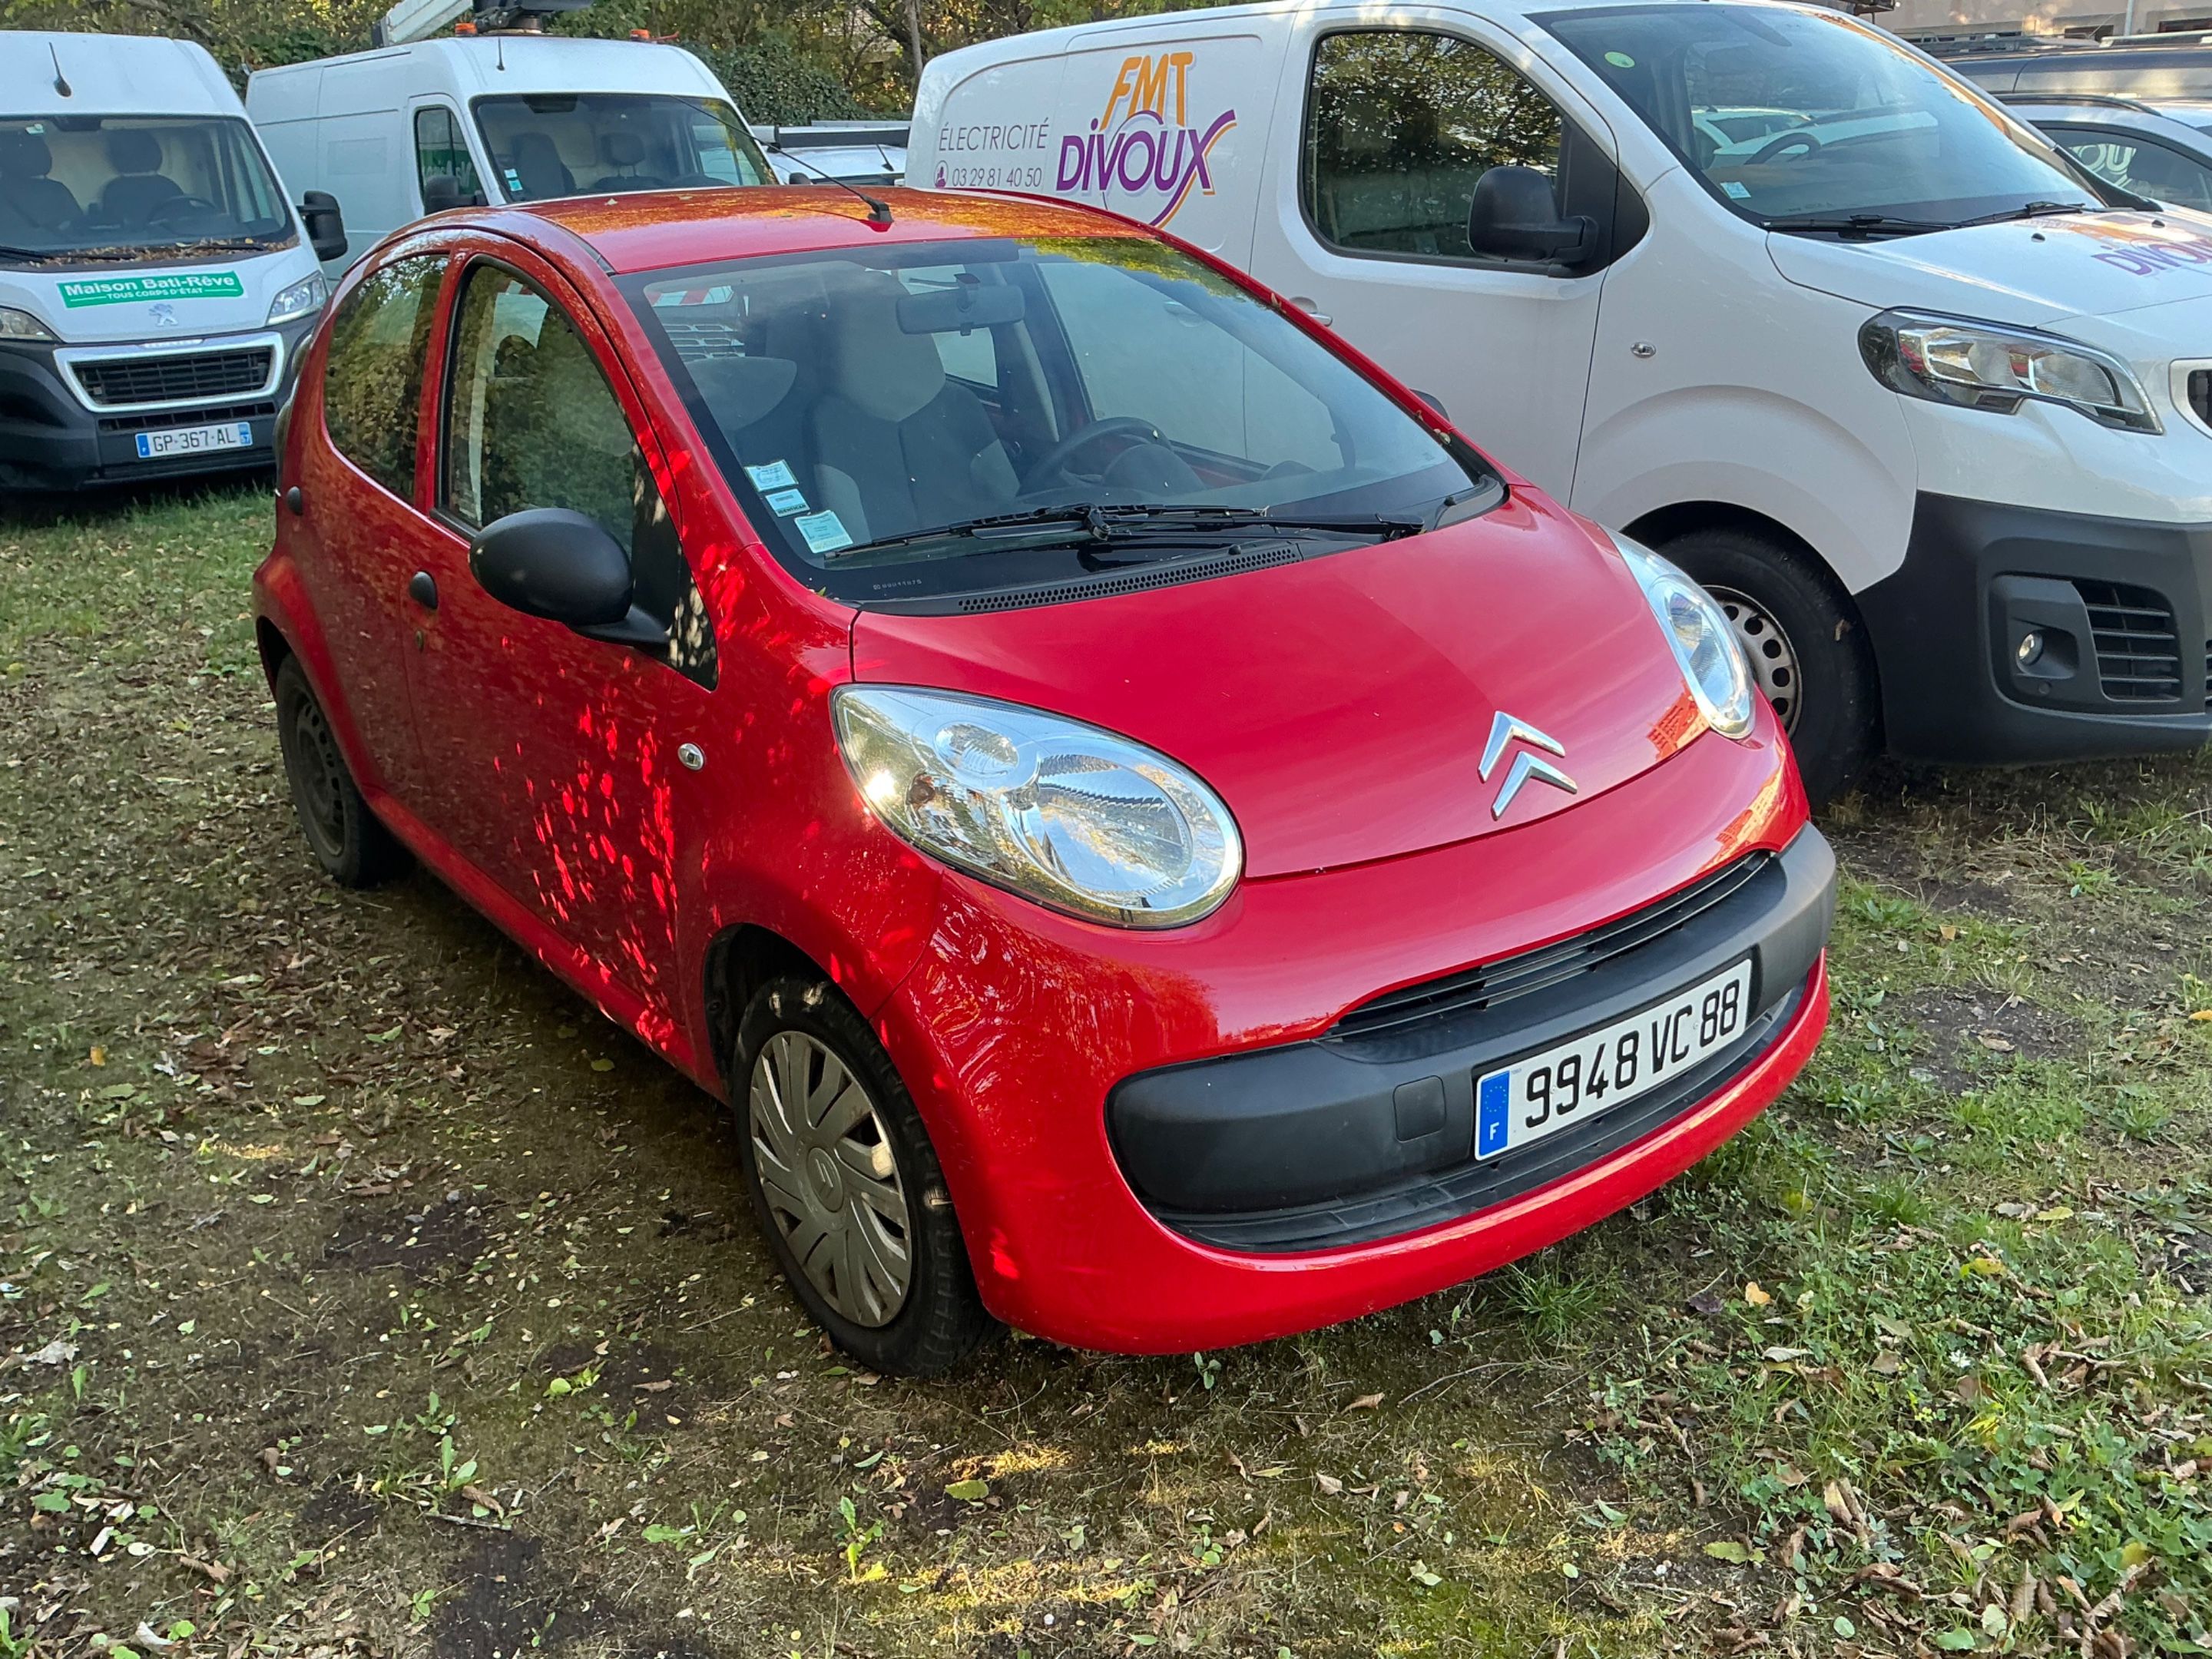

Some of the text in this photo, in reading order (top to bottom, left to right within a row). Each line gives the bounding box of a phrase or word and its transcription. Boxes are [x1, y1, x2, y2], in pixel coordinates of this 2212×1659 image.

[1099, 51, 1194, 131] FMT
[938, 117, 1049, 151] ÉLECTRICITÉ
[952, 167, 1042, 187] 03 29 81 40 50
[65, 276, 234, 296] Maison Bati-Rêve
[106, 291, 134, 300] TOUS
[135, 289, 168, 297] CORPS
[1489, 979, 1740, 1141] F 9948 VC 88
